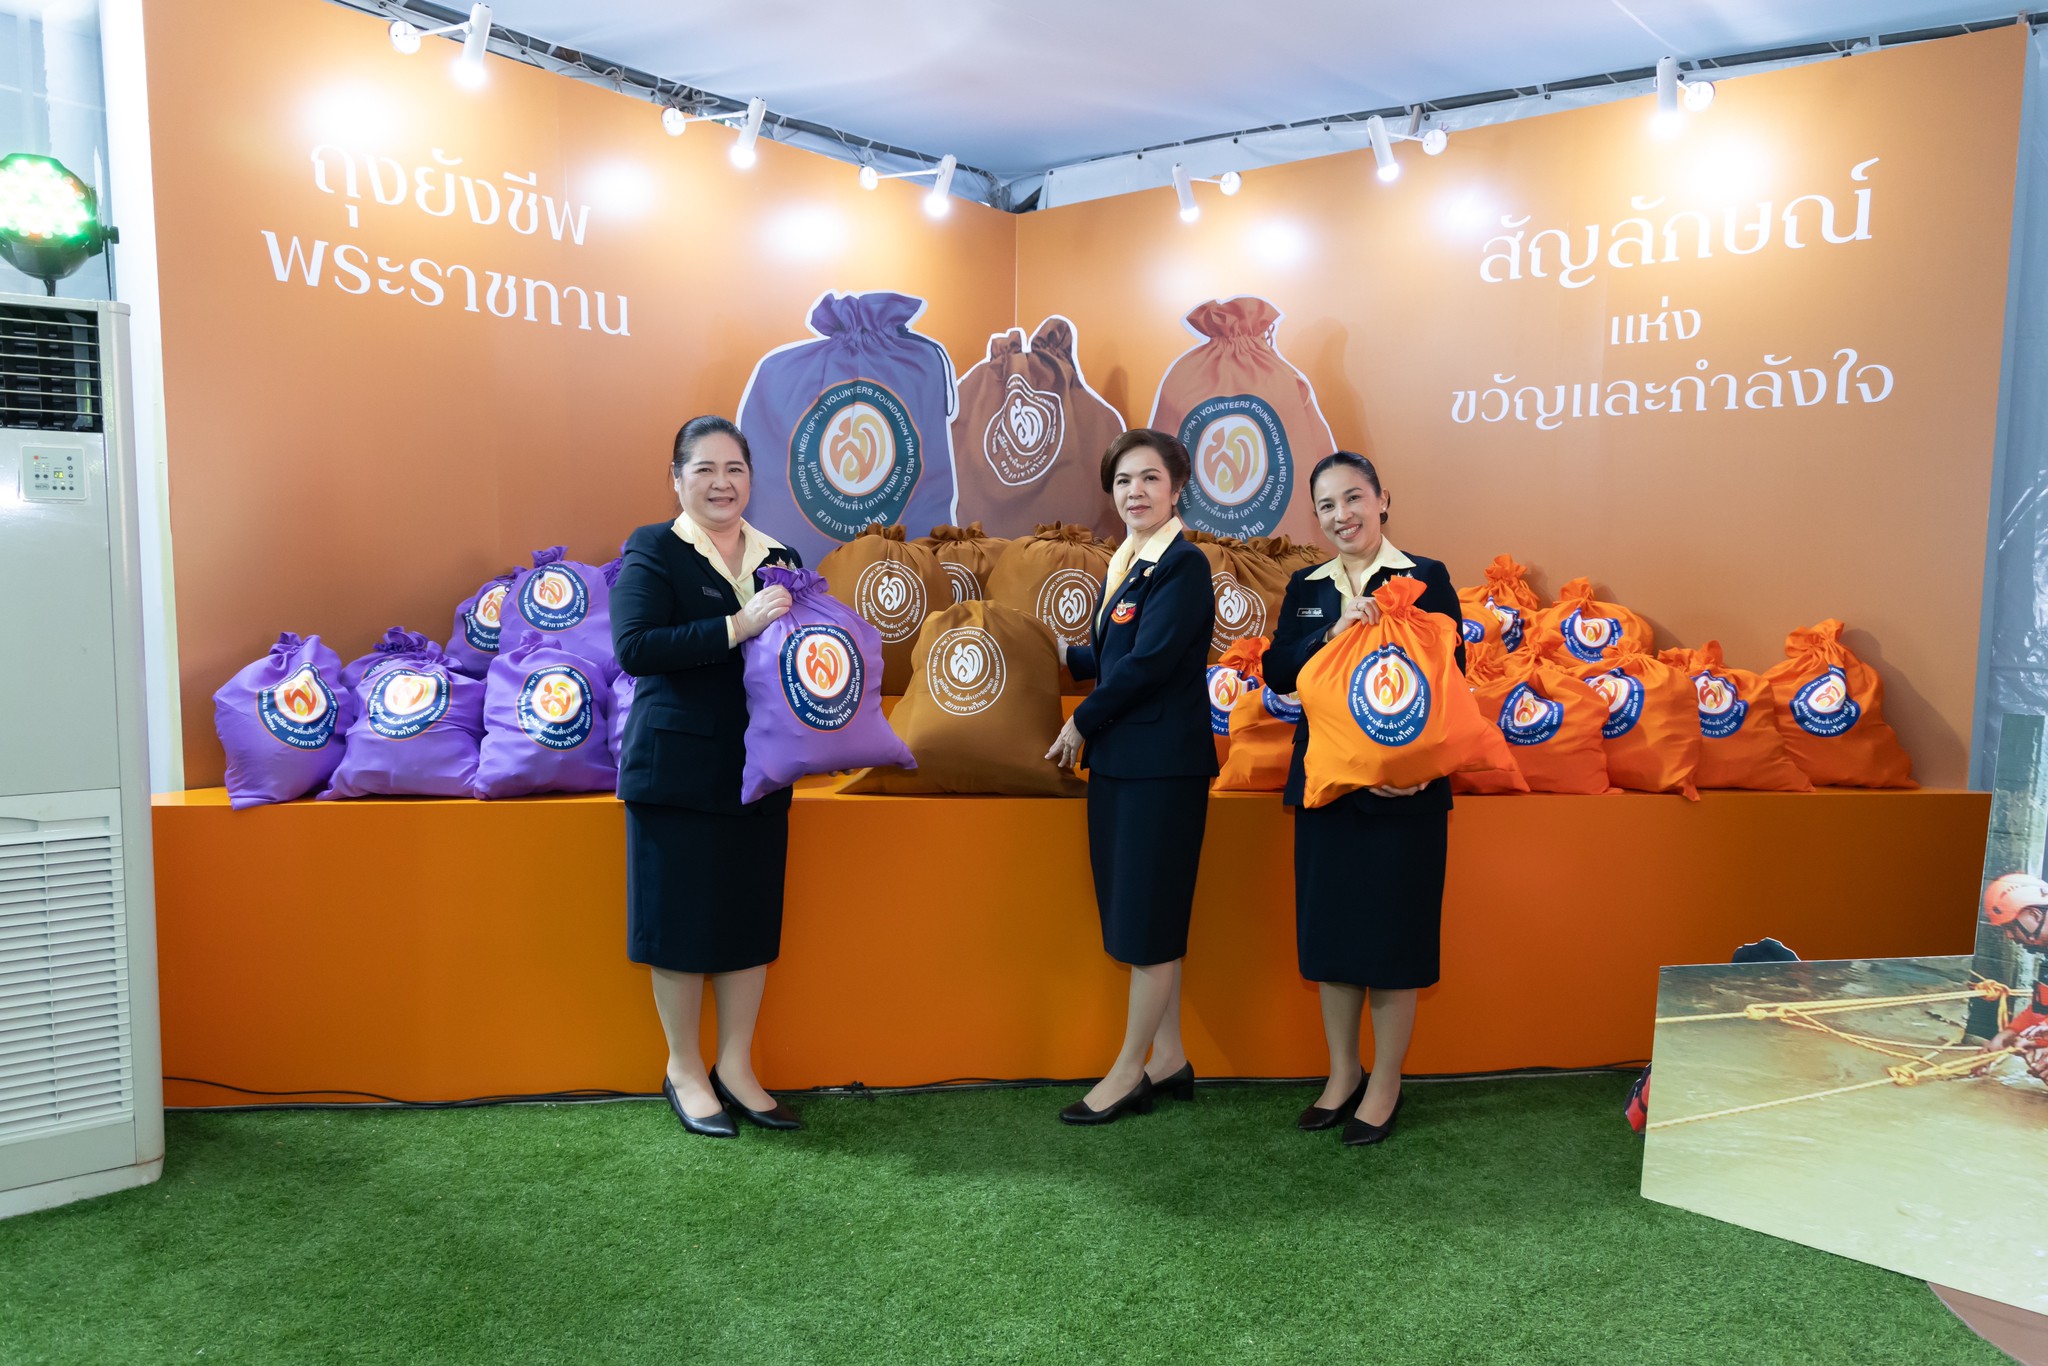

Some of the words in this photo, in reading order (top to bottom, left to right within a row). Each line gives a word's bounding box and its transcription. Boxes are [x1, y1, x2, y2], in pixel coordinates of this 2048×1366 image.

[311, 144, 591, 245] ถุงยังชีพ
[1479, 157, 1880, 289] สัญลักษณ์
[261, 230, 630, 336] พระราชทาน
[1611, 296, 1701, 345] แห่ง
[1450, 348, 1894, 430] ขวัญและกำลังใจ
[874, 392, 909, 436] FOUNDATION
[1200, 401, 1250, 416] VOLUNTEERS
[1251, 403, 1280, 445] FOUNDATION
[798, 433, 809, 454] NEED
[906, 437, 914, 456] THAI
[1276, 445, 1285, 464] THAI
[798, 466, 813, 500] FRIENDS
[1269, 485, 1285, 511] CROSS
[827, 628, 855, 655] FOUNDATION
